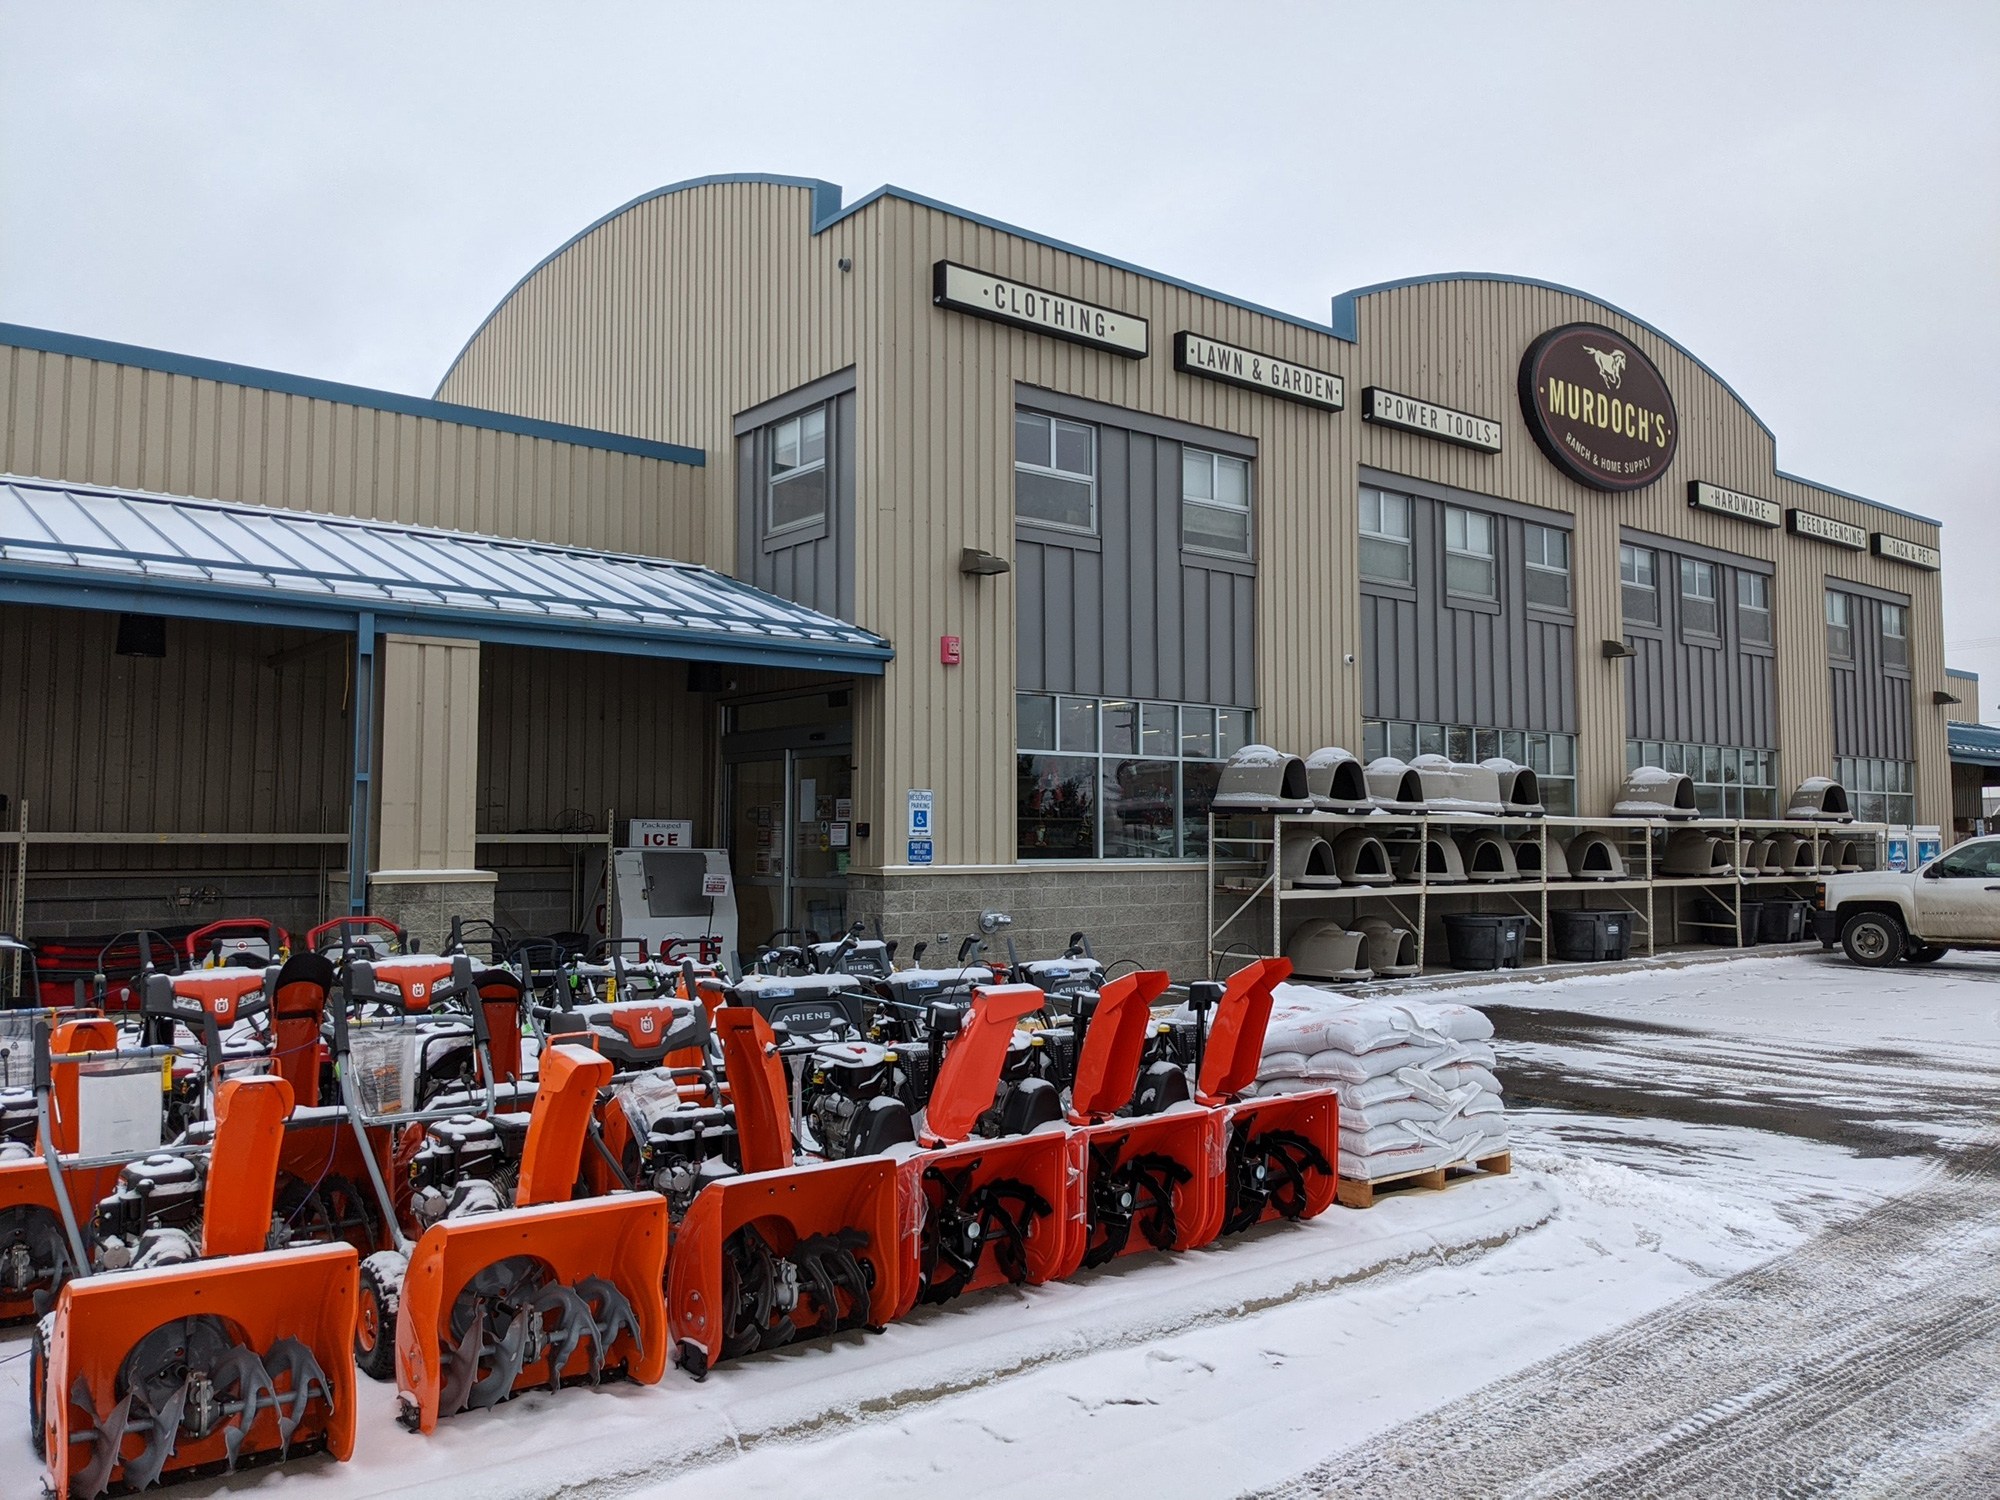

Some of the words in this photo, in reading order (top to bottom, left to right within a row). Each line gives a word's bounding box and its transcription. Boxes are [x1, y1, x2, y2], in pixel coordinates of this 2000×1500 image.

[994, 283, 1106, 338] CLOTHING
[1197, 341, 1243, 376] LAWN
[1252, 358, 1262, 382] &
[1271, 363, 1334, 402] GARDEN
[1384, 396, 1437, 430] POWER
[1446, 413, 1491, 444] TOOLS
[1549, 376, 1666, 448] MURDOCH'S
[1565, 432, 1591, 461] RANCH
[1593, 454, 1599, 466] &
[1600, 457, 1622, 473] HOME
[1624, 456, 1651, 474] SUPPLY
[1714, 489, 1765, 519] HARDWARE
[1801, 514, 1821, 534] FEED
[1822, 520, 1828, 536] &
[1830, 522, 1862, 545] FENCING
[1892, 540, 1909, 558] TACK
[1911, 545, 1917, 560] &
[1918, 548, 1930, 564] PET
[644, 833, 679, 846] ICE
[1060, 985, 1090, 994] ARIENS
[782, 1011, 831, 1022] ARIENS
